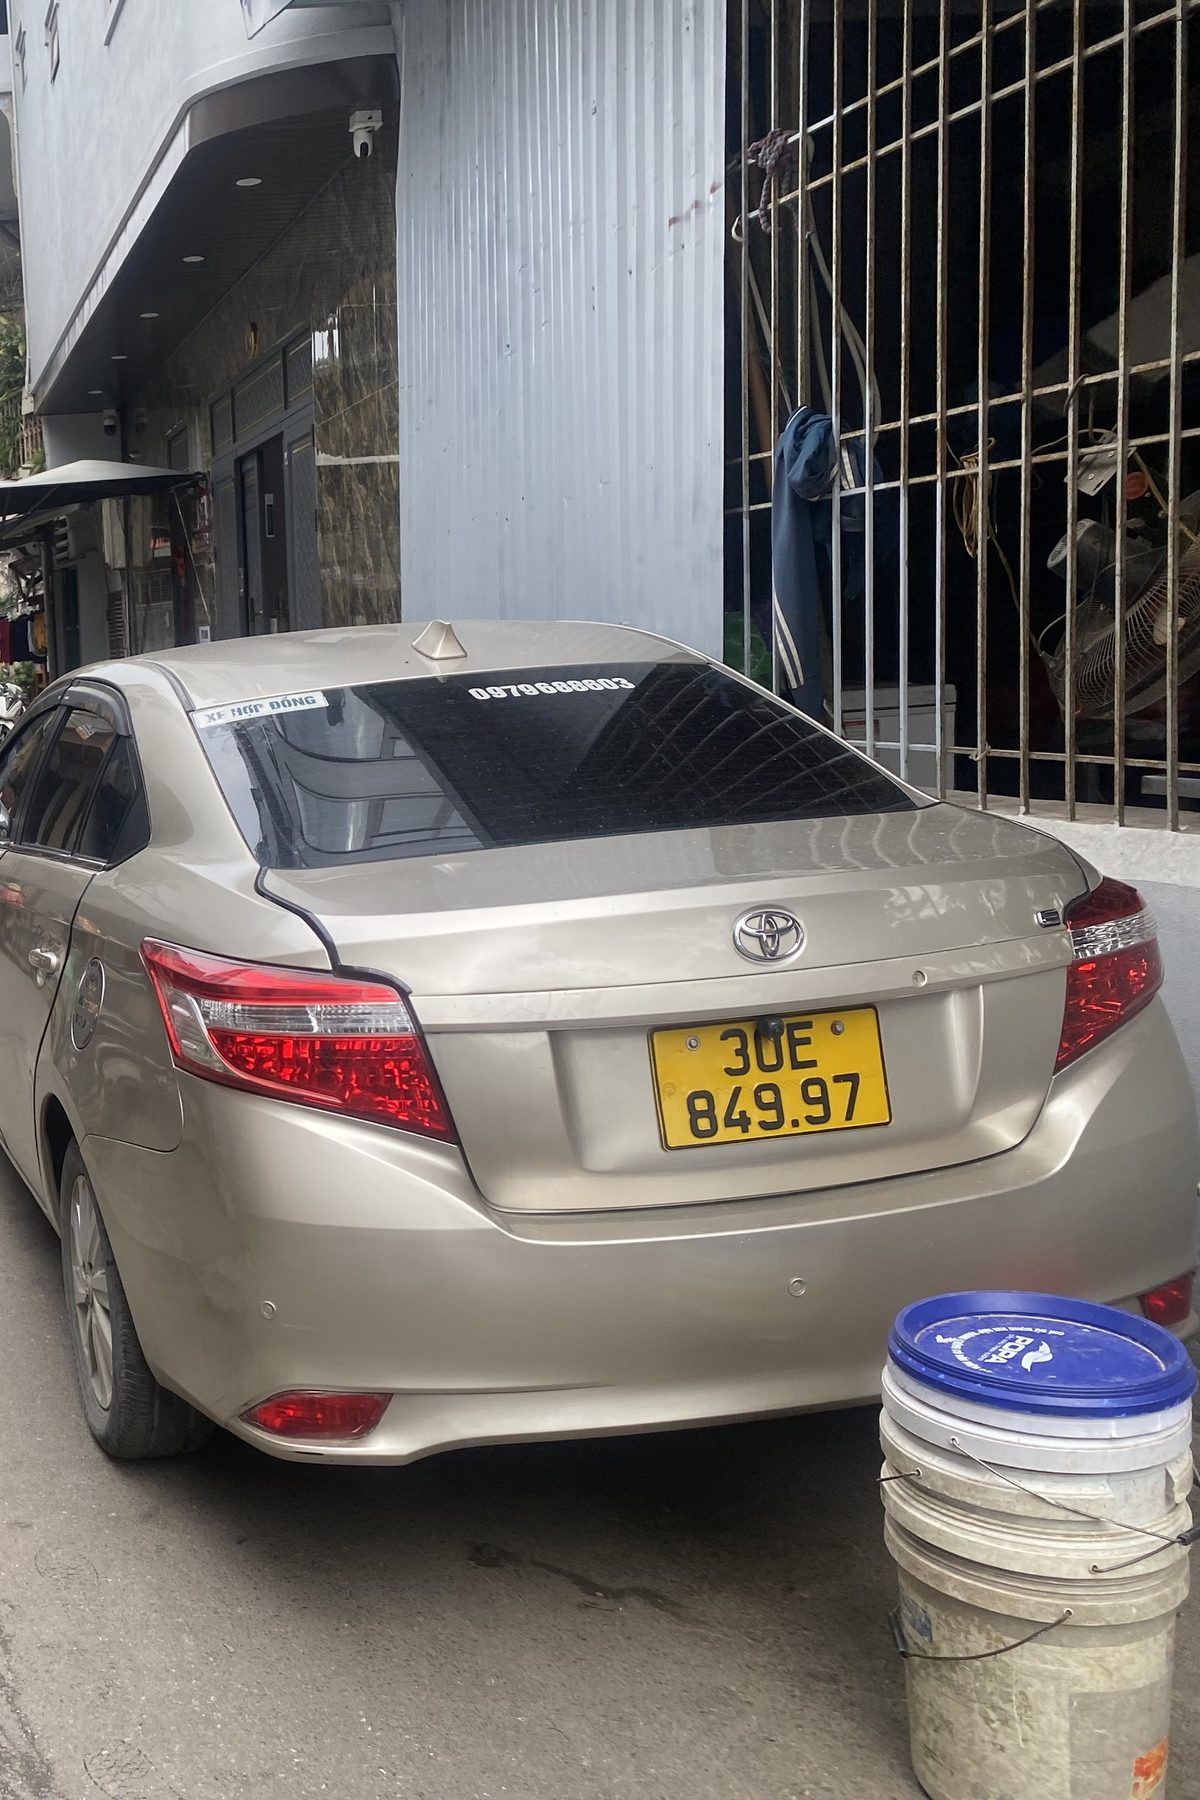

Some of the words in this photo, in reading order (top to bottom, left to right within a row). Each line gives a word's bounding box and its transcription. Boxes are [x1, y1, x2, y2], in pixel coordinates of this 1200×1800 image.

[468, 677, 636, 700] 0979688603
[720, 1021, 818, 1076] 30E
[686, 1072, 860, 1139] 849.97
[984, 1335, 1035, 1364] POPA
